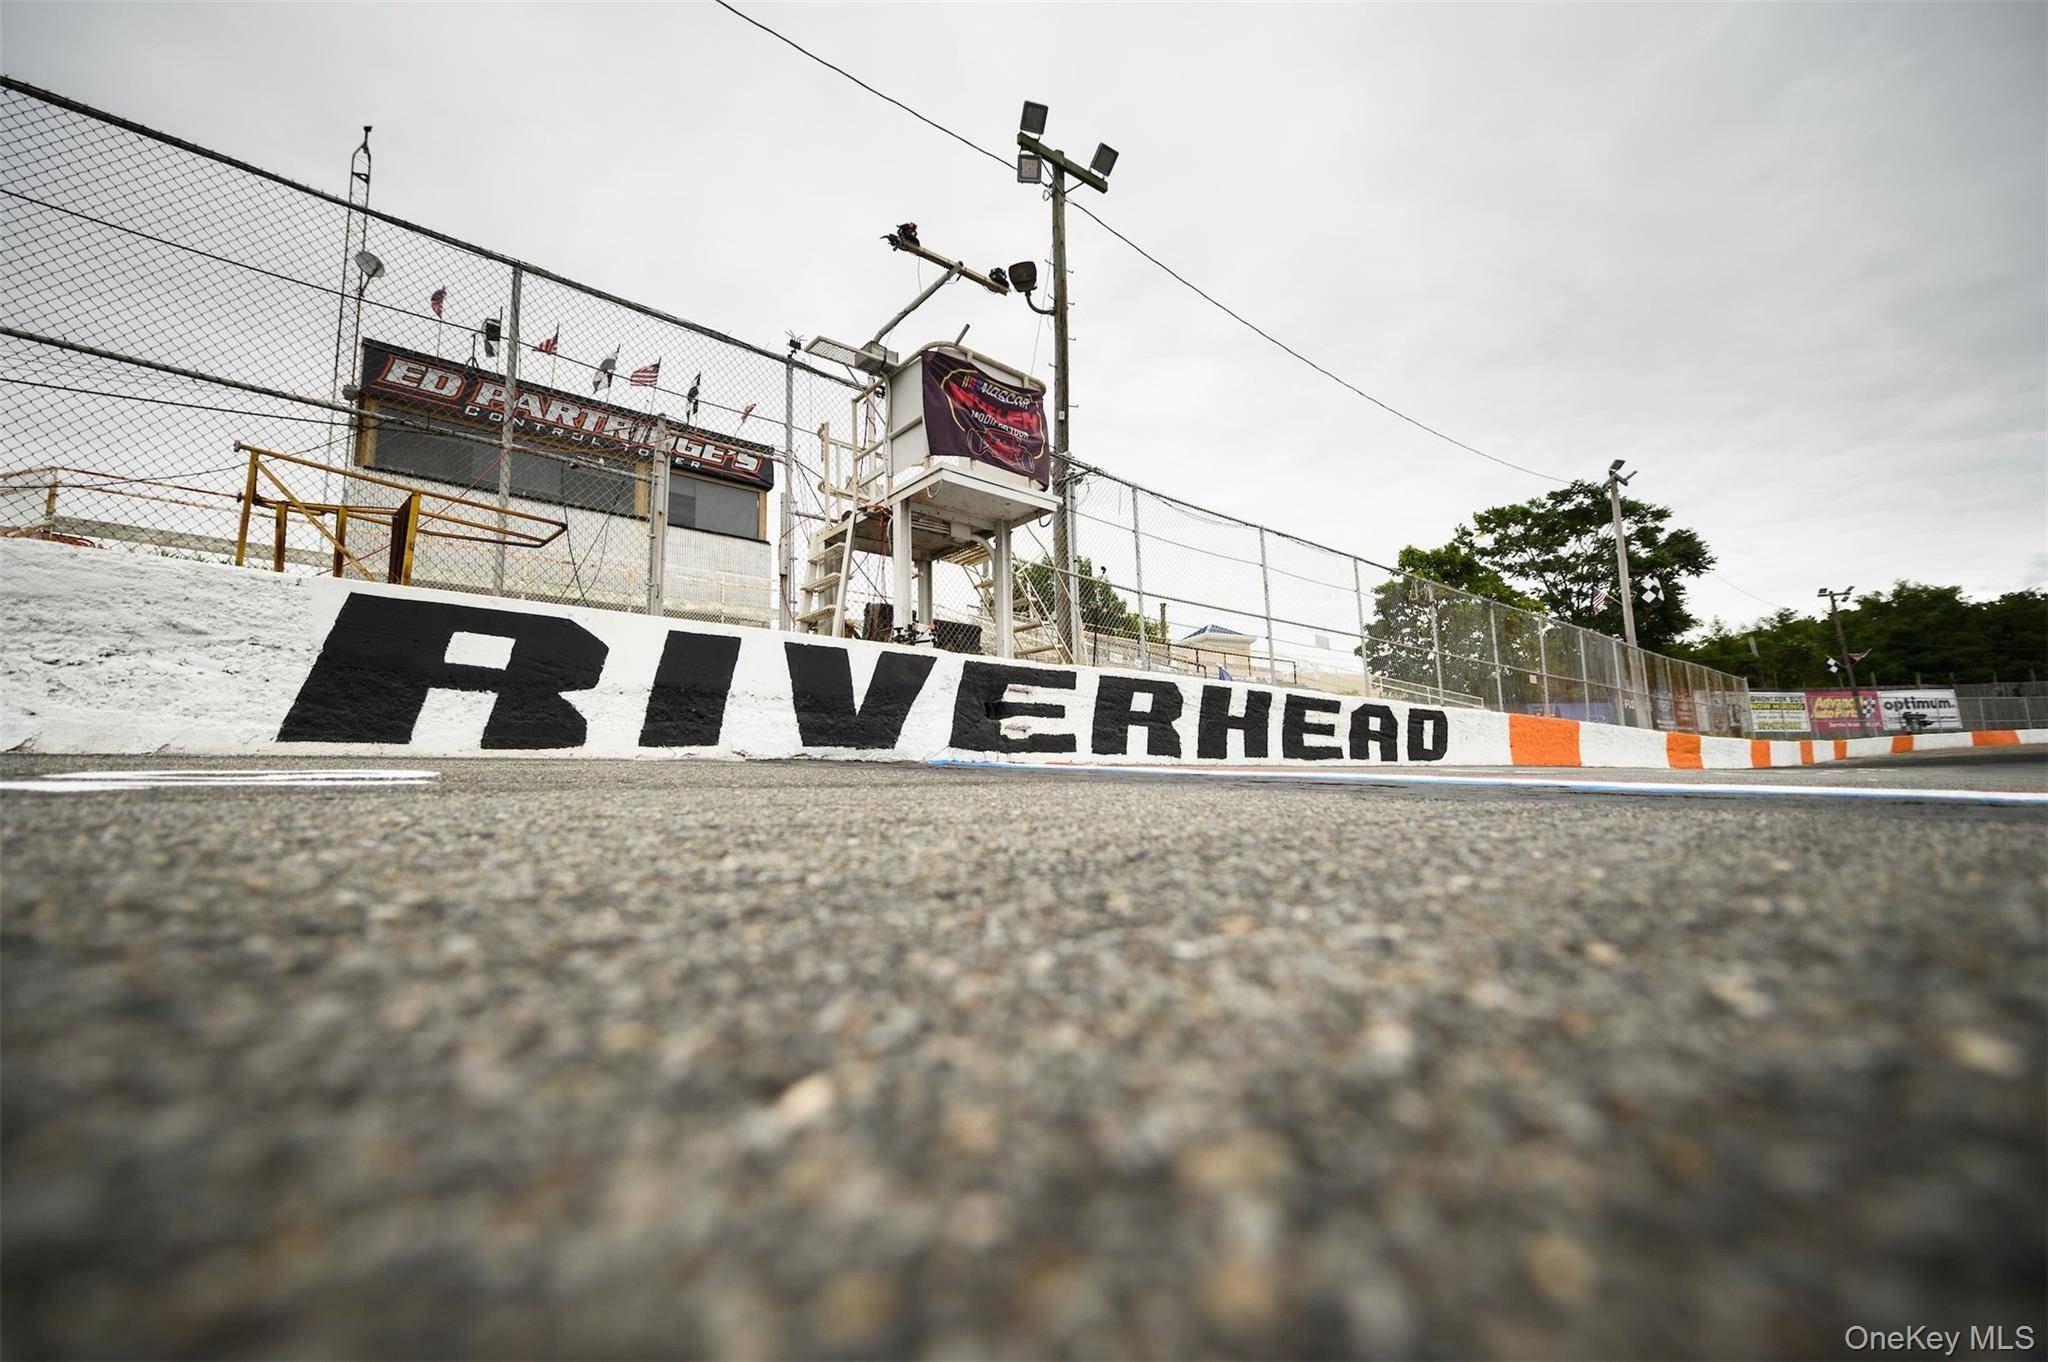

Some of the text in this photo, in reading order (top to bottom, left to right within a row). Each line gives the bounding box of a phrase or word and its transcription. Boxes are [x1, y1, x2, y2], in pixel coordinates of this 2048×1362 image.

[383, 357, 465, 398] ED
[979, 382, 1031, 410] NASCAR
[465, 405, 701, 469] CONTROL TOER
[277, 592, 1447, 761] RIVERHEAD
